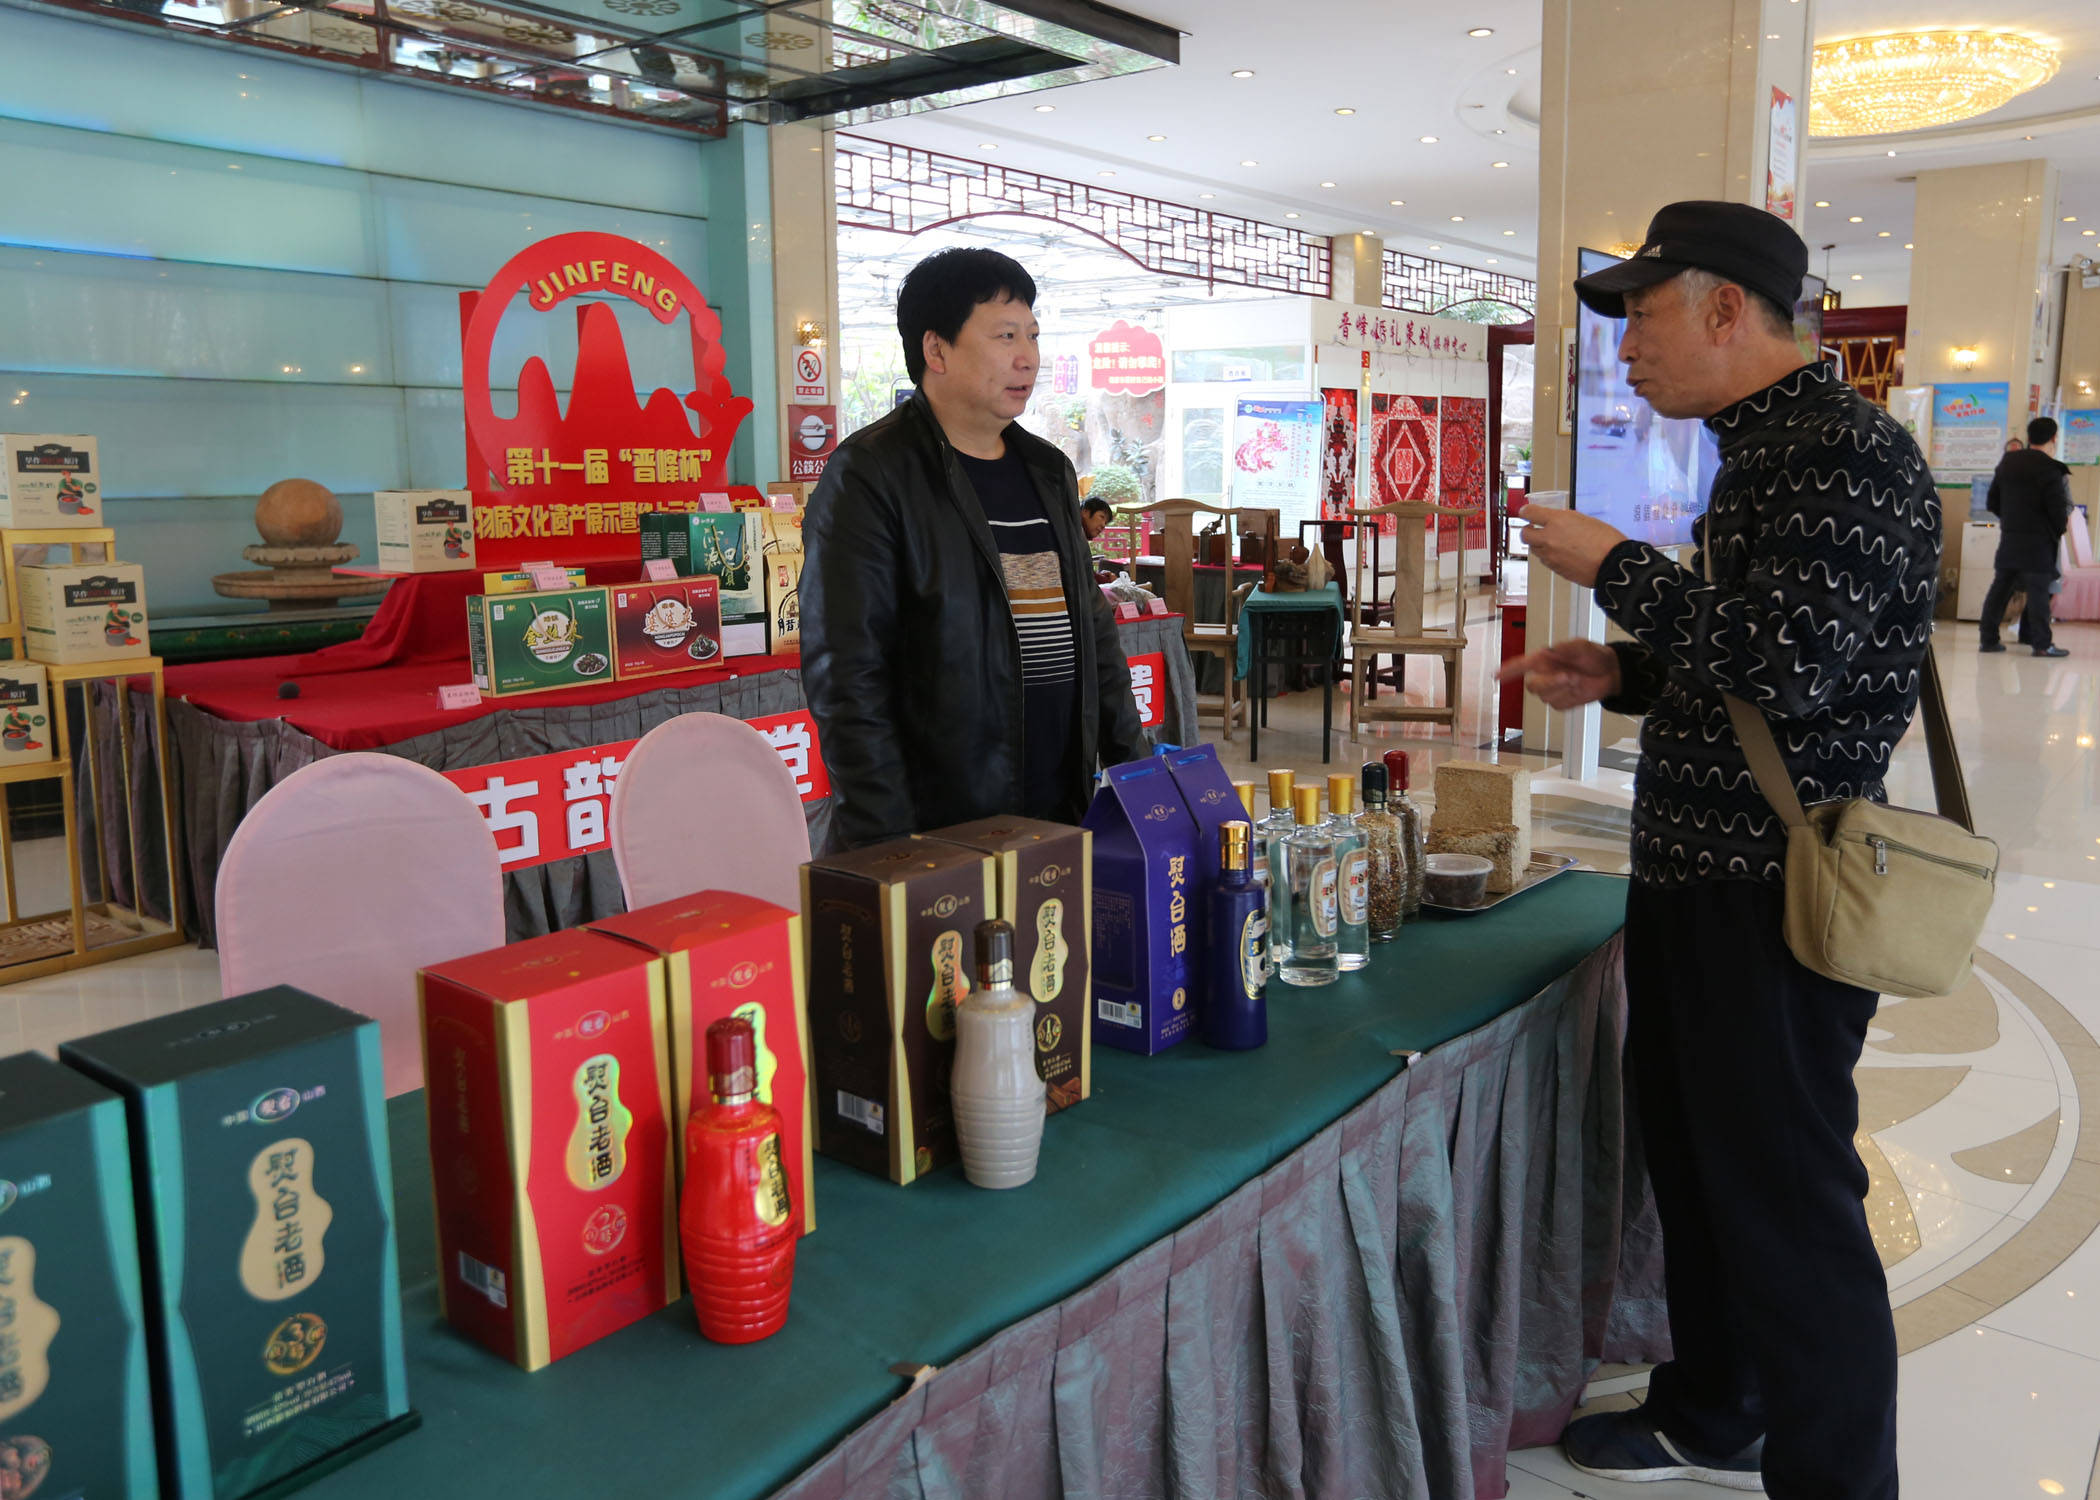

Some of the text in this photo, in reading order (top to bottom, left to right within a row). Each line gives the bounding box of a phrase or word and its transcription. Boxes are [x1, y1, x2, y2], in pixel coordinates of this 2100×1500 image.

[538, 259, 677, 311] JINFENG
[793, 459, 829, 475] 公筷公
